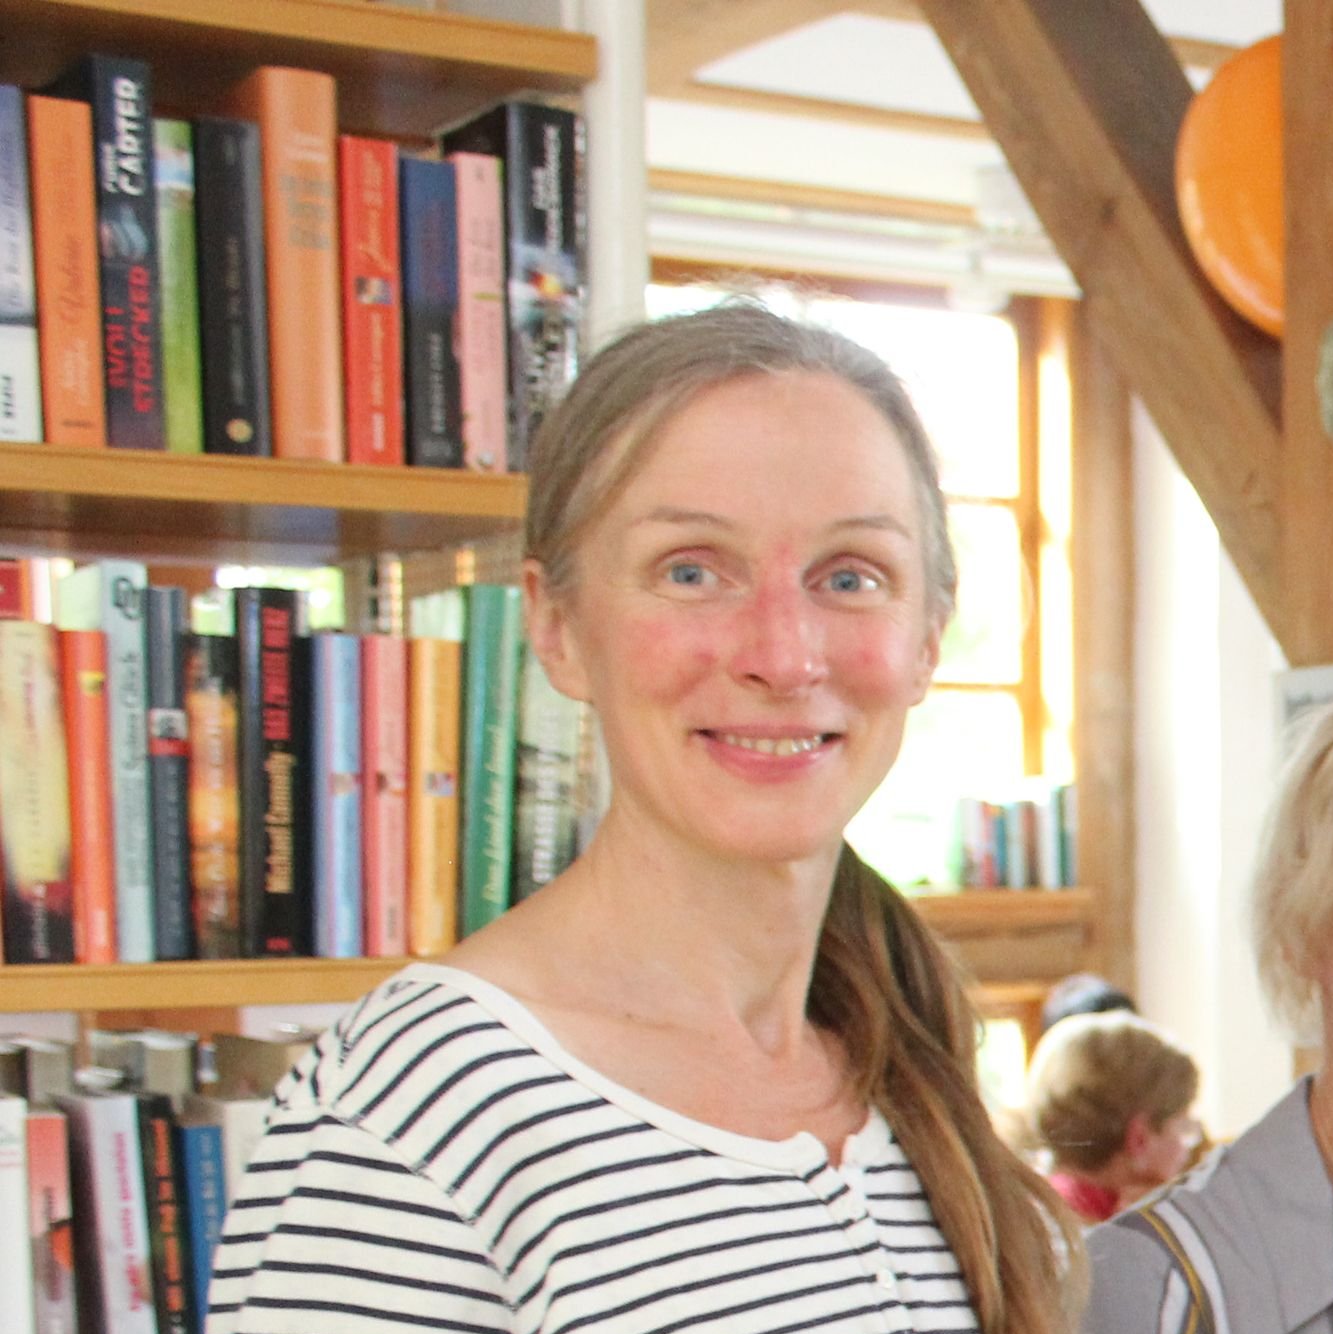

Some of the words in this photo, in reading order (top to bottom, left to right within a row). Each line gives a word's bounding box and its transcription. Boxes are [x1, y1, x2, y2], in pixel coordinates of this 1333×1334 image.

[117, 77, 142, 197] CARTER
[265, 751, 297, 825] Connelly
[265, 826, 293, 894] Michael
